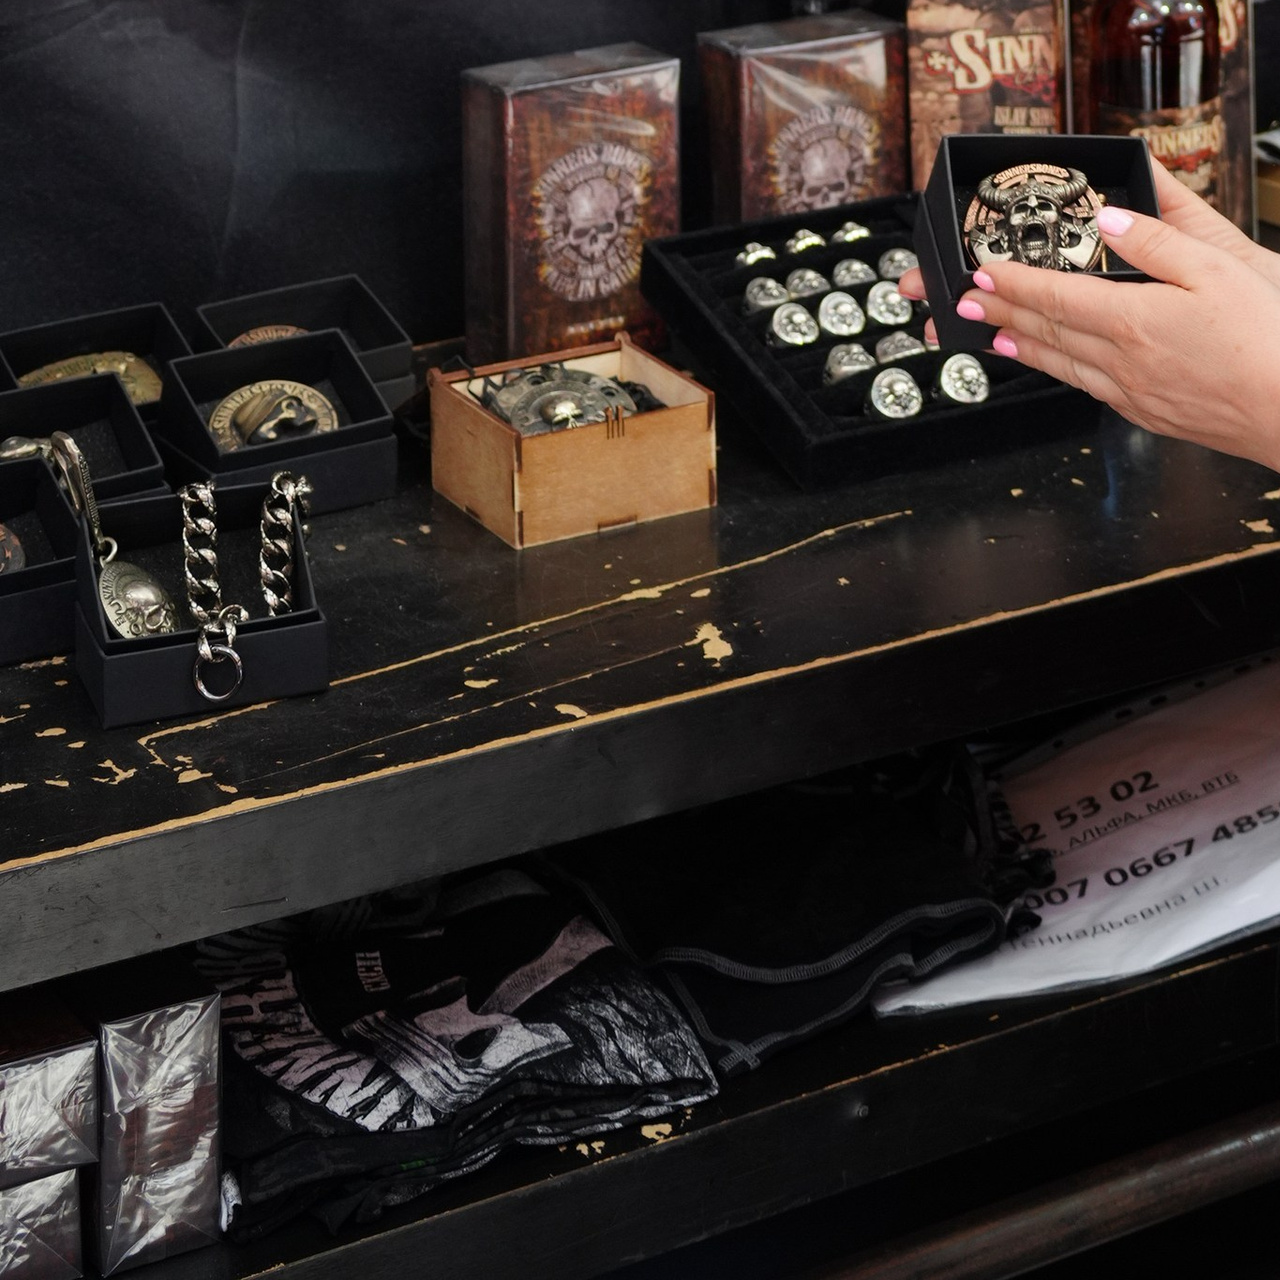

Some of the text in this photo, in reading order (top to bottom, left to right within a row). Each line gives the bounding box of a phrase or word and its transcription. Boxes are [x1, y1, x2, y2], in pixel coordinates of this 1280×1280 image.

[1053, 795, 1103, 831] 53
[1109, 769, 1160, 803] 02
[1103, 837, 1196, 888] 0667
